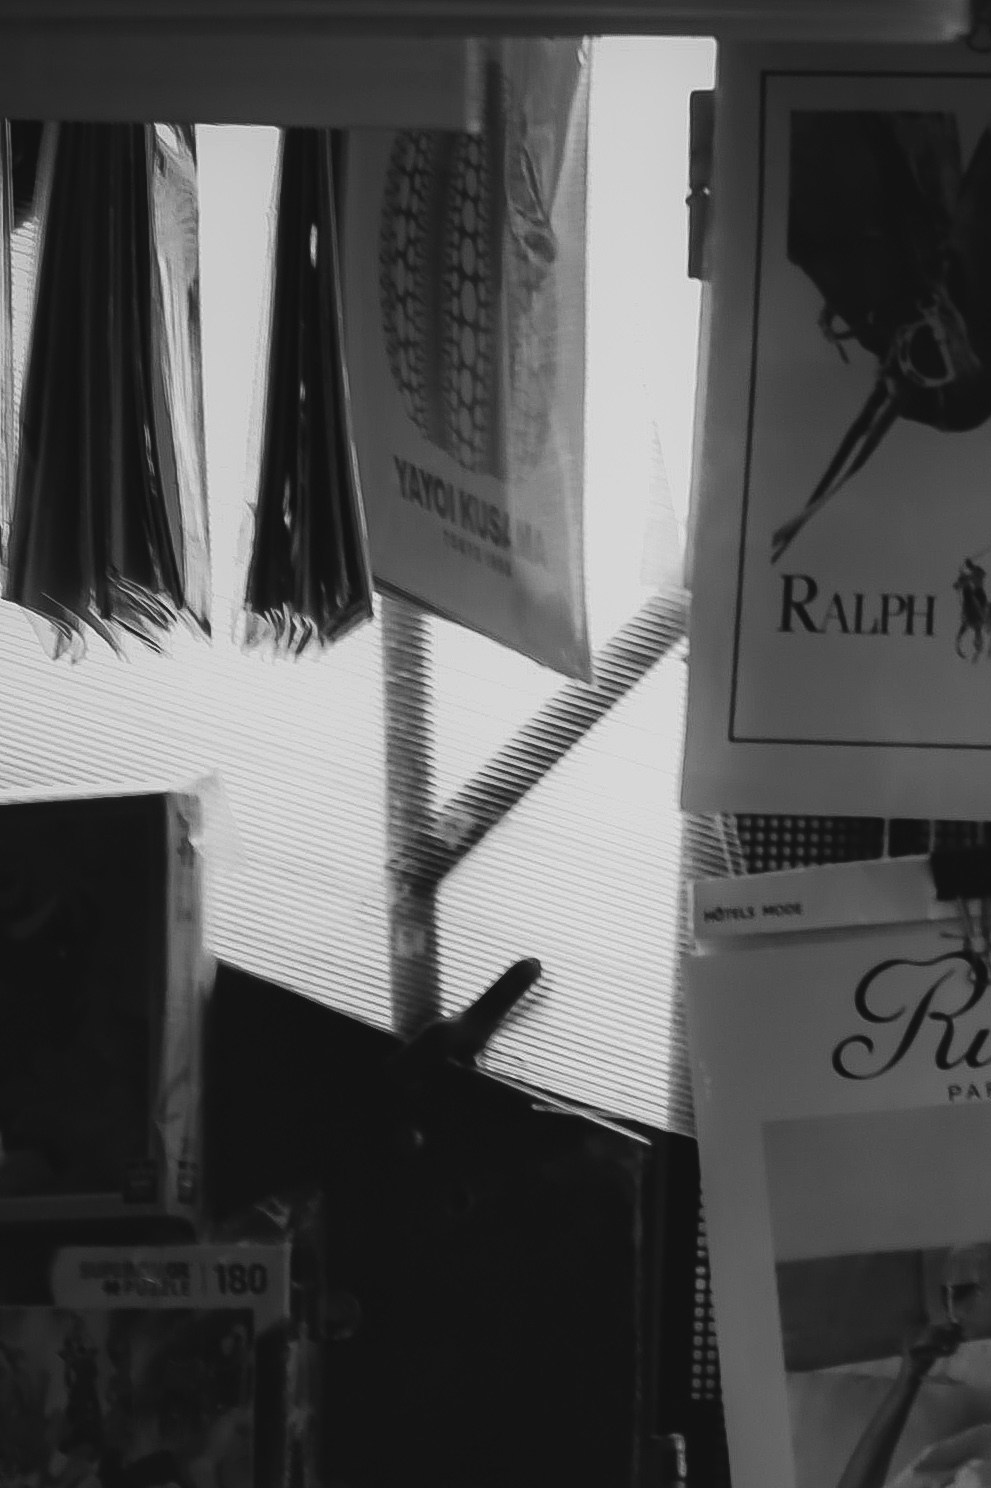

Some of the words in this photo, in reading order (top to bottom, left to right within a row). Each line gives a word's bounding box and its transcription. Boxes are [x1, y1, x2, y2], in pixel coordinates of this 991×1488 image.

[393, 455, 457, 524] YAYOI
[776, 572, 937, 638] RALPH
[213, 1263, 268, 1295] 180
